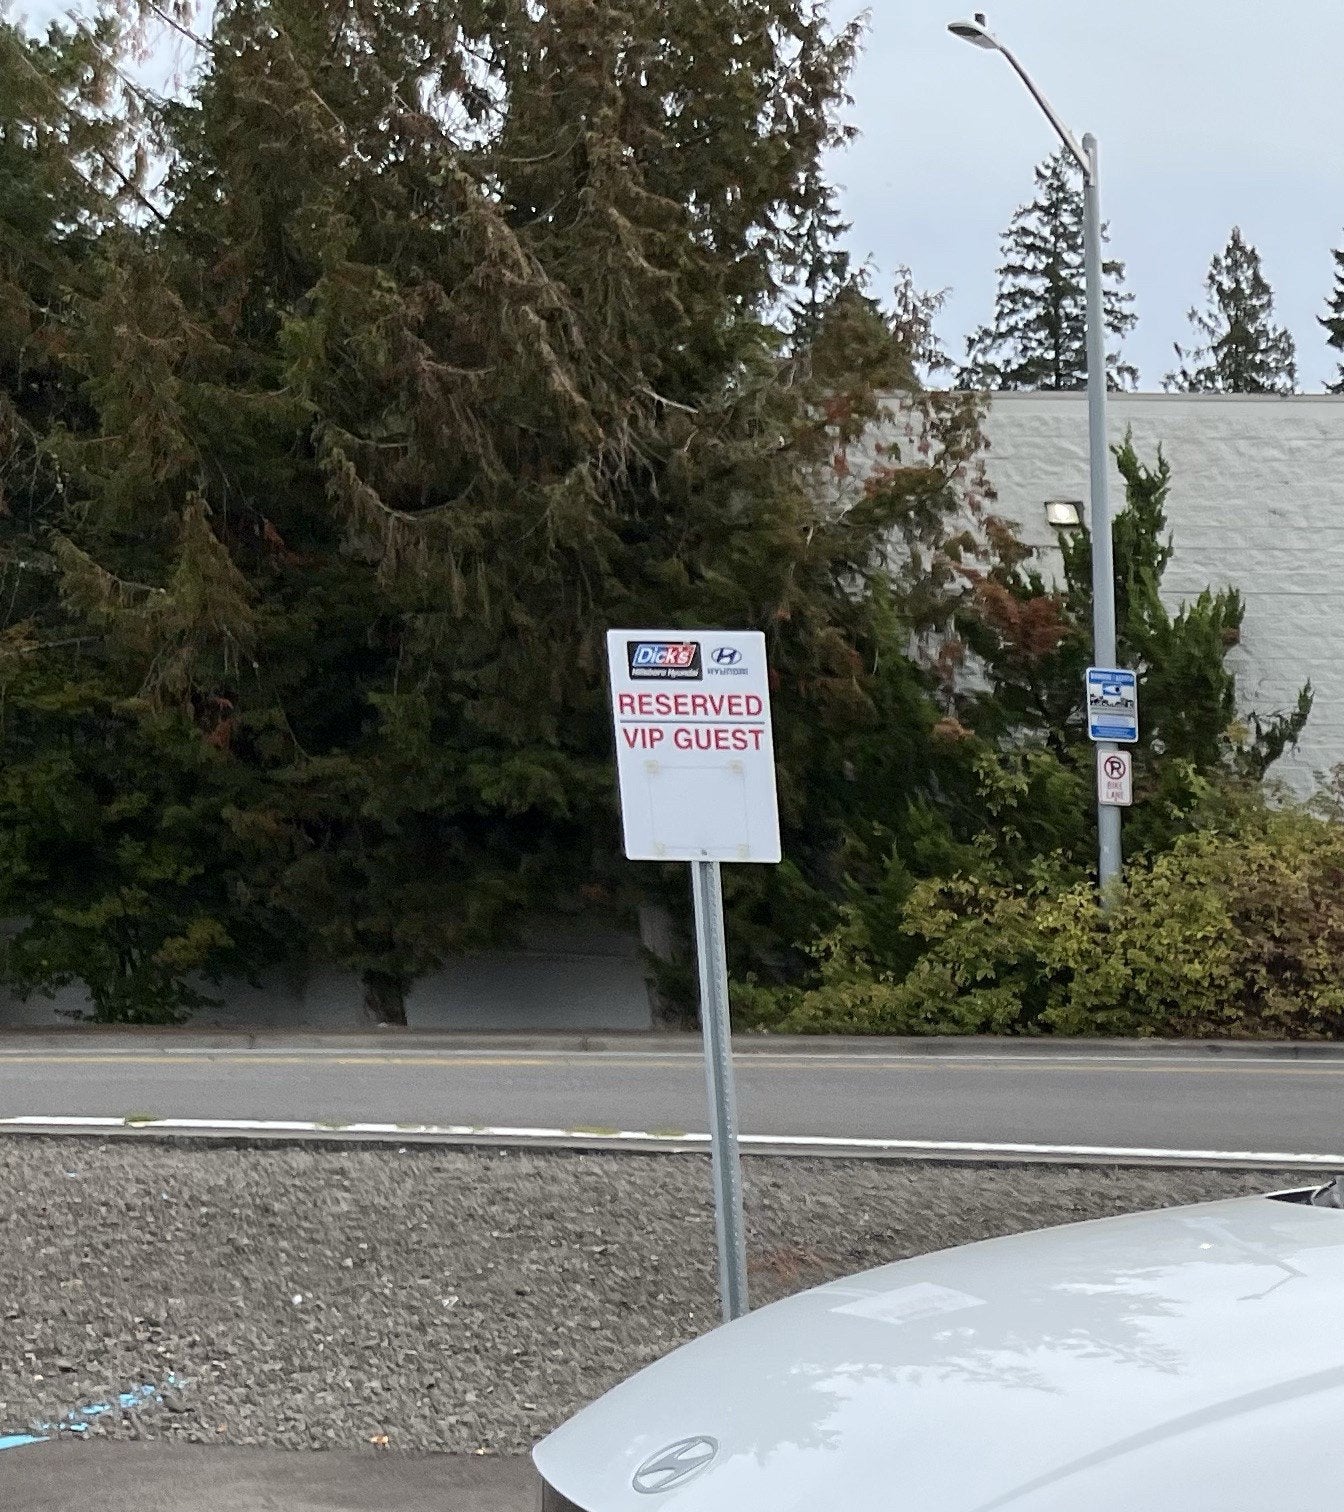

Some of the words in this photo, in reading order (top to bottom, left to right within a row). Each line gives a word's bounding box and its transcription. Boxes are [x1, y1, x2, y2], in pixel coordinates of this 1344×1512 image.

[637, 646, 690, 664] Dick's
[618, 693, 763, 716] RESERVED
[622, 728, 664, 750] VIP
[673, 728, 765, 751] GUEST
